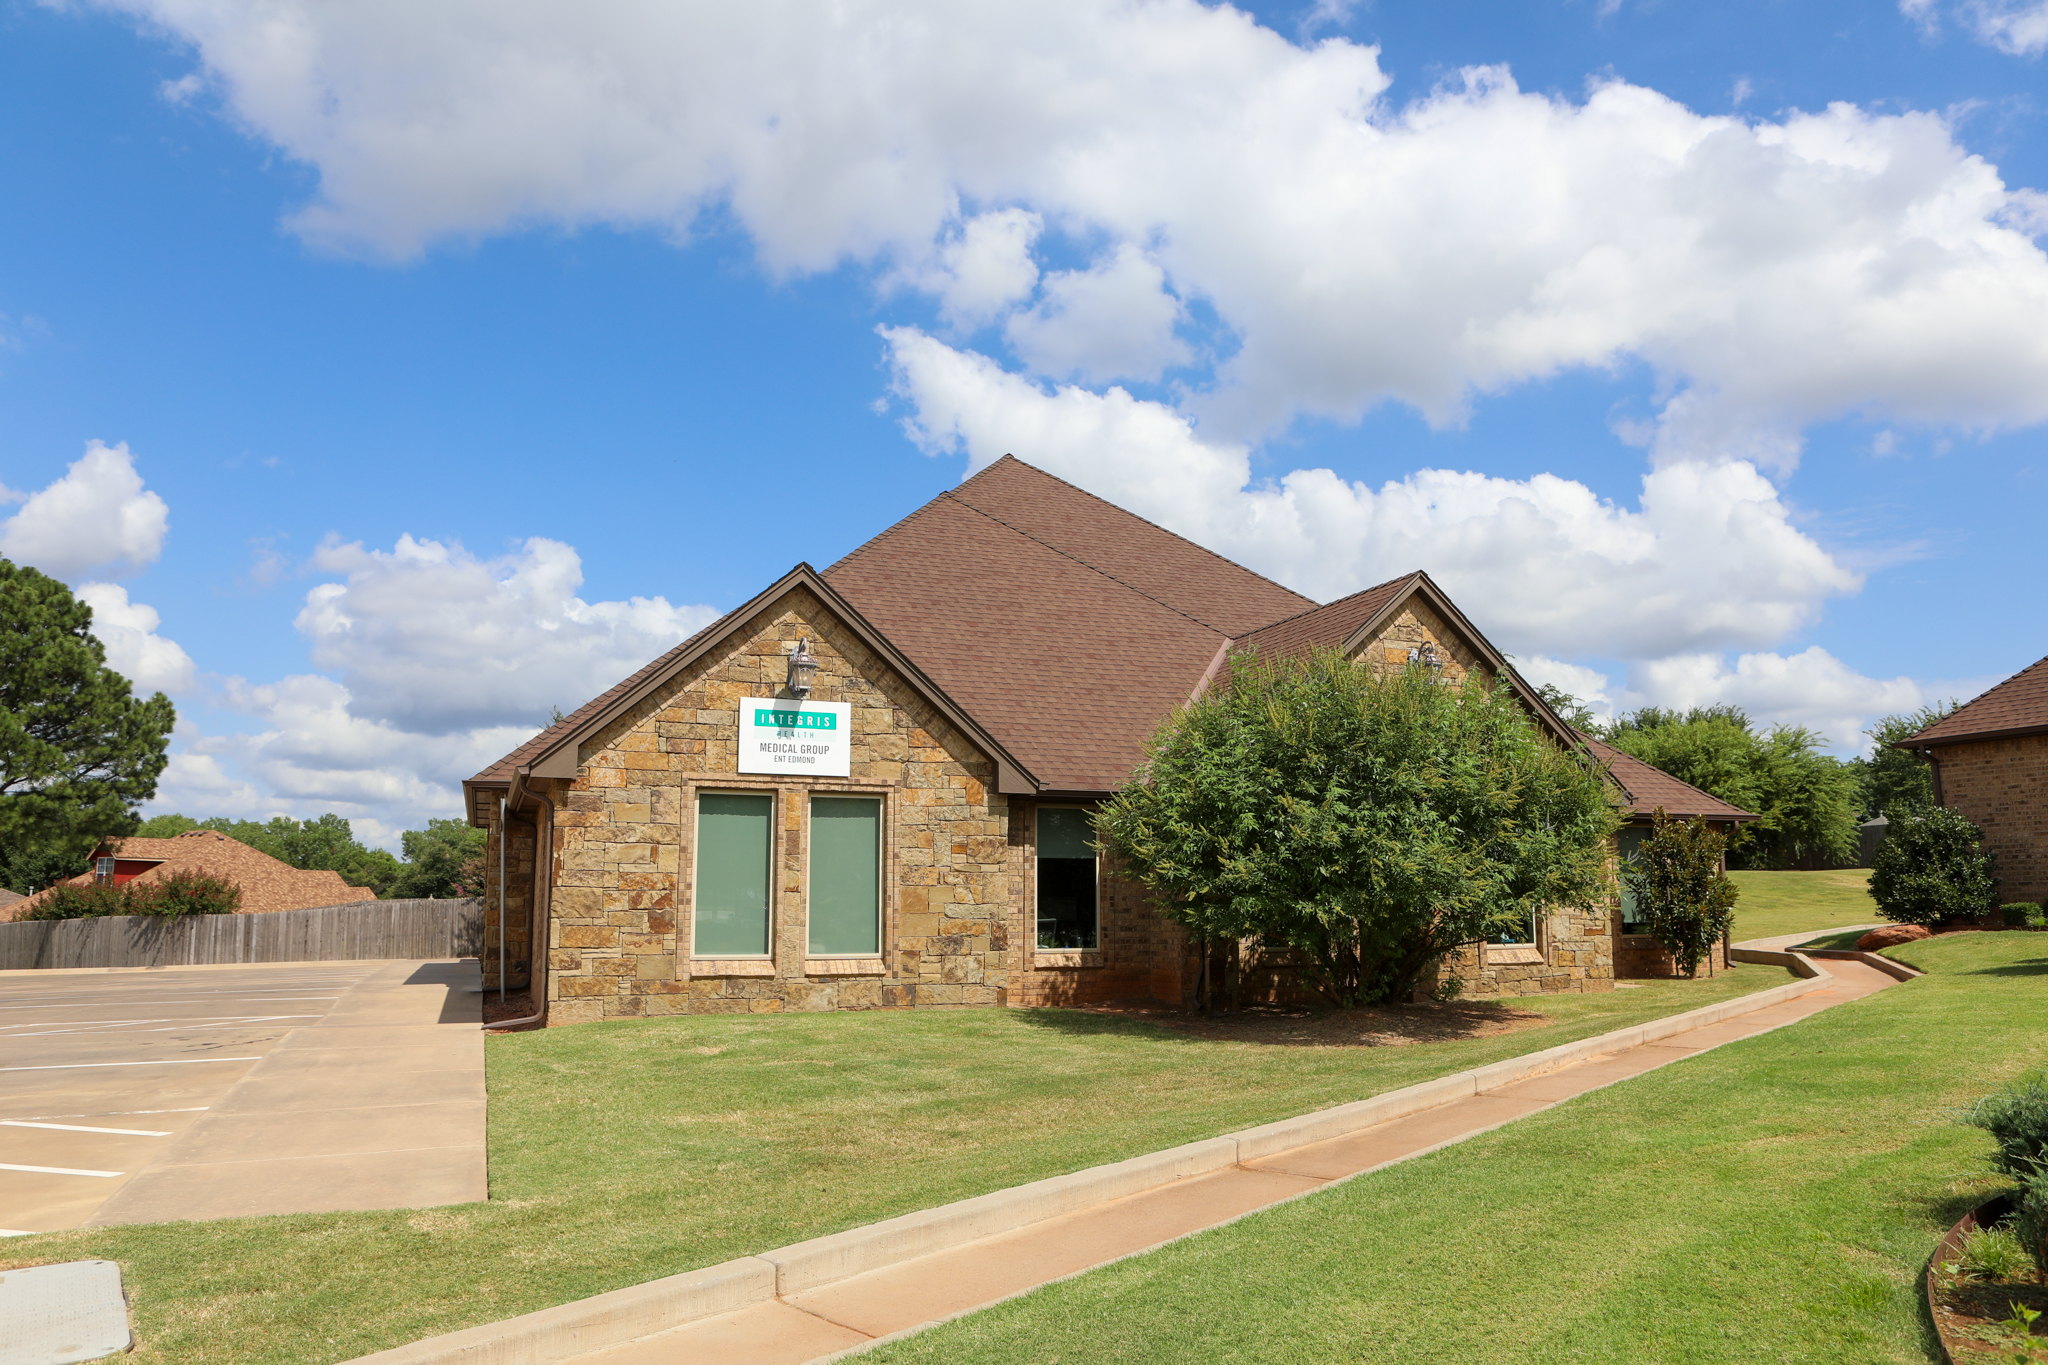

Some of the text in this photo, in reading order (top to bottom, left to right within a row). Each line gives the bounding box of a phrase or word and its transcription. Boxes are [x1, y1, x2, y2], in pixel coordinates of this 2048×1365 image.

[761, 713, 830, 727] INTEGRIS
[777, 730, 814, 738] HEALTH
[759, 742, 830, 755] MEDICAL GROUP
[774, 755, 815, 764] ENT EDMOND
